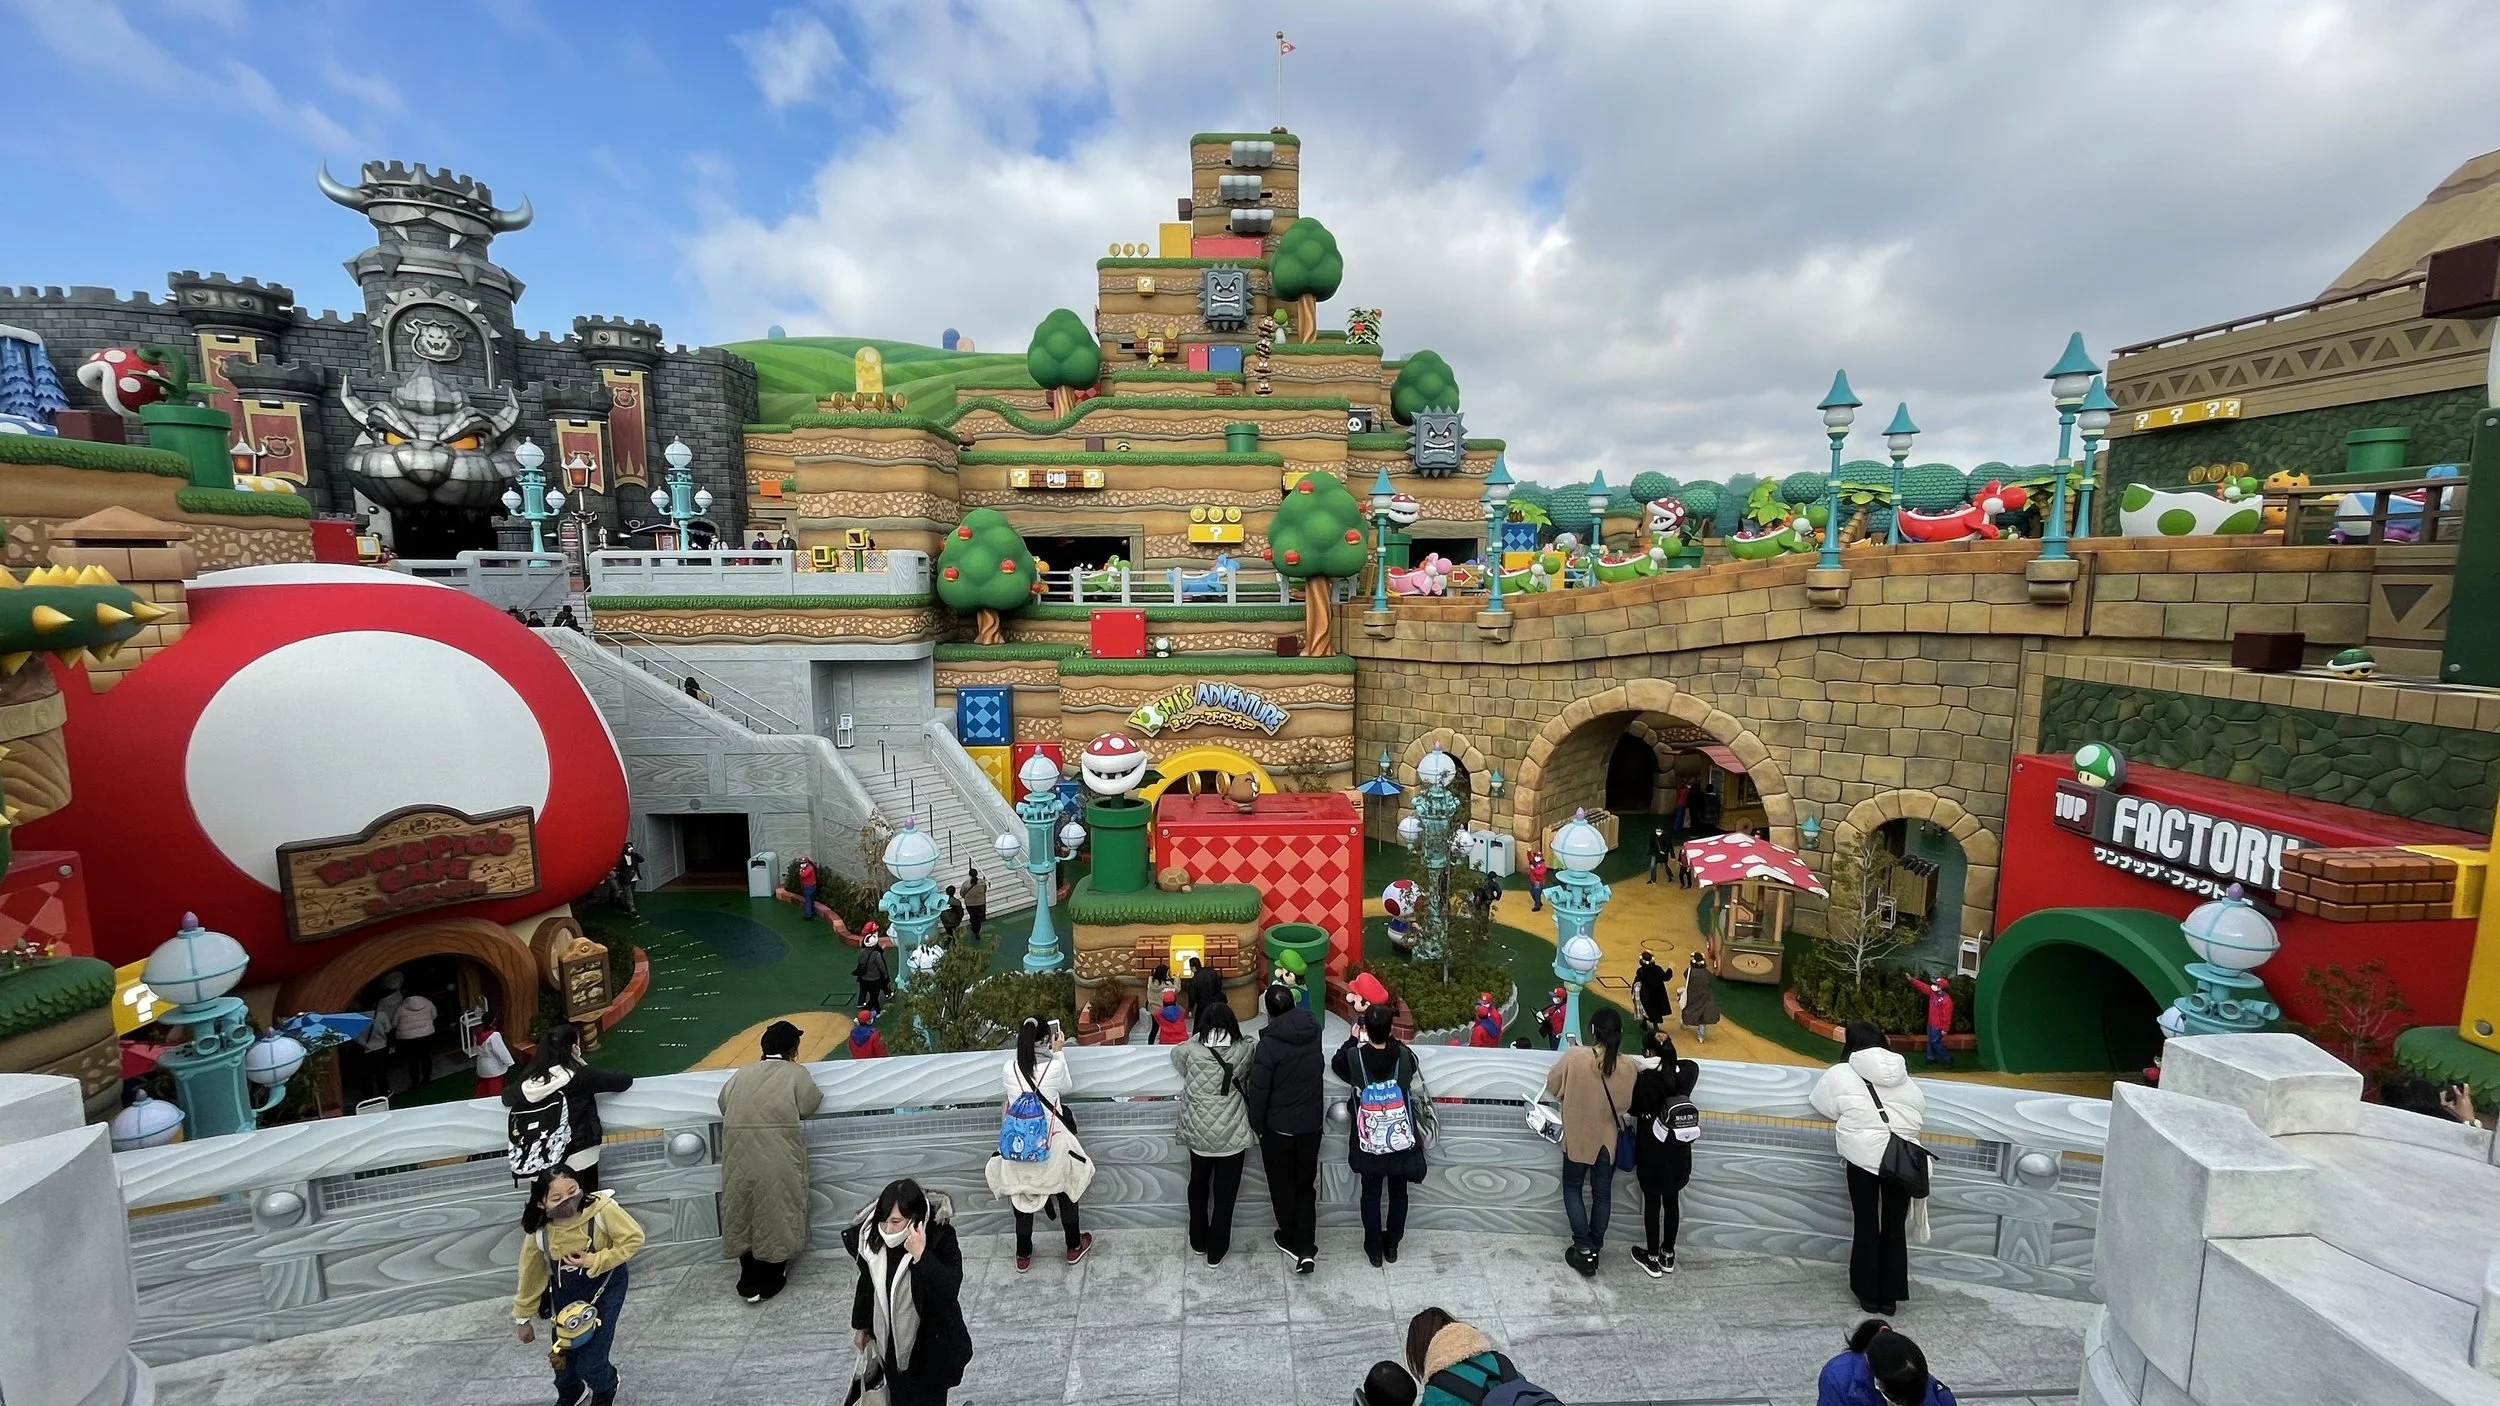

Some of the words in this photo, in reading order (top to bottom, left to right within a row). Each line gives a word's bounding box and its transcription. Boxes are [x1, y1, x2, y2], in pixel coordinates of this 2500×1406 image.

[1047, 473, 1067, 484] POW
[1196, 681, 1287, 732] ADVENTURE
[2055, 791, 2088, 822] 1UP
[2111, 796, 2300, 891] FACTORY
[2093, 846, 2254, 906] ワンナップ・ファクト
